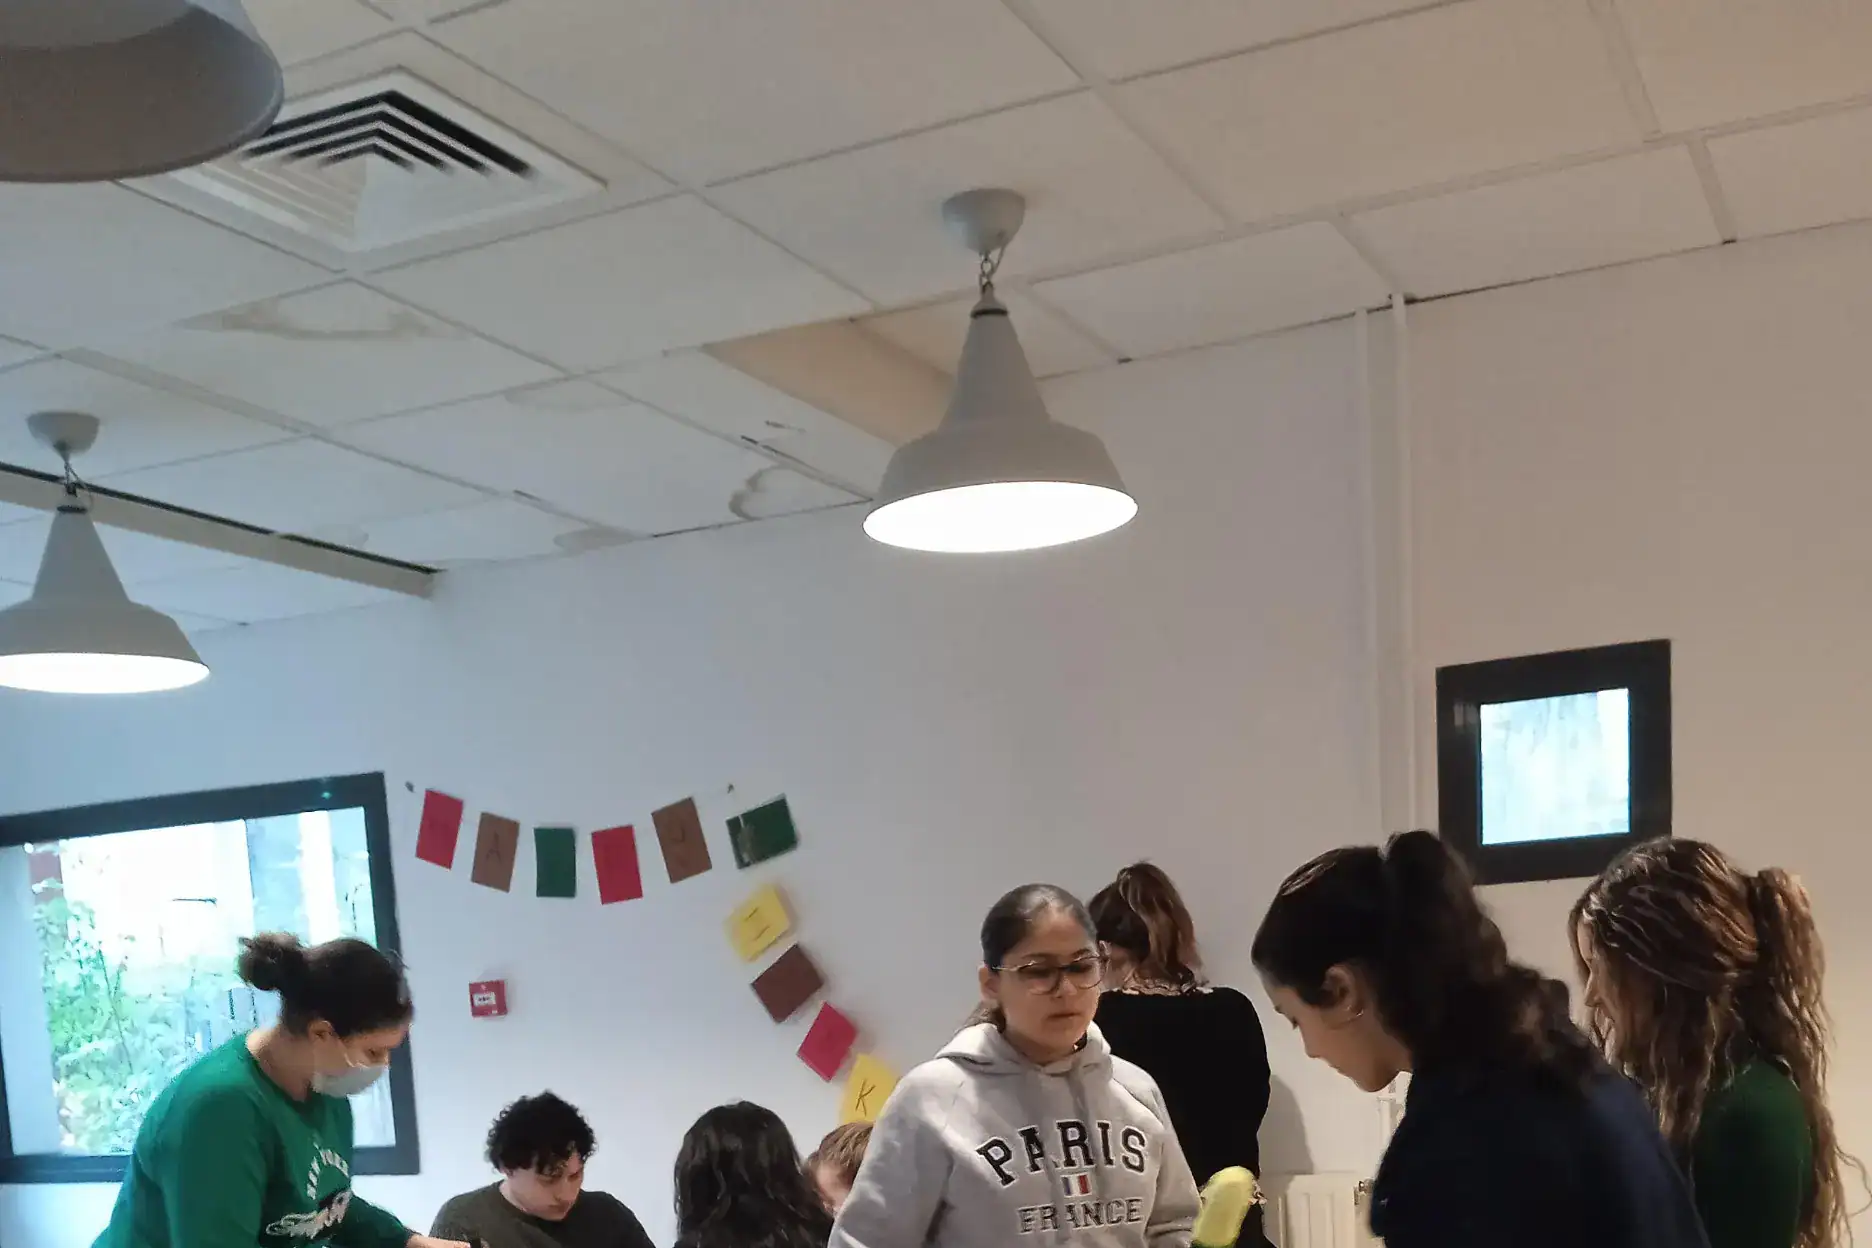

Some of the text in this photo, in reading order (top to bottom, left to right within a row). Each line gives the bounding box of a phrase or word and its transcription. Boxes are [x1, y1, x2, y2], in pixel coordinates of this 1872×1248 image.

[855, 1077, 876, 1117] K
[975, 1119, 1148, 1188] PARIS
[1017, 1198, 1143, 1234] FRANCE
